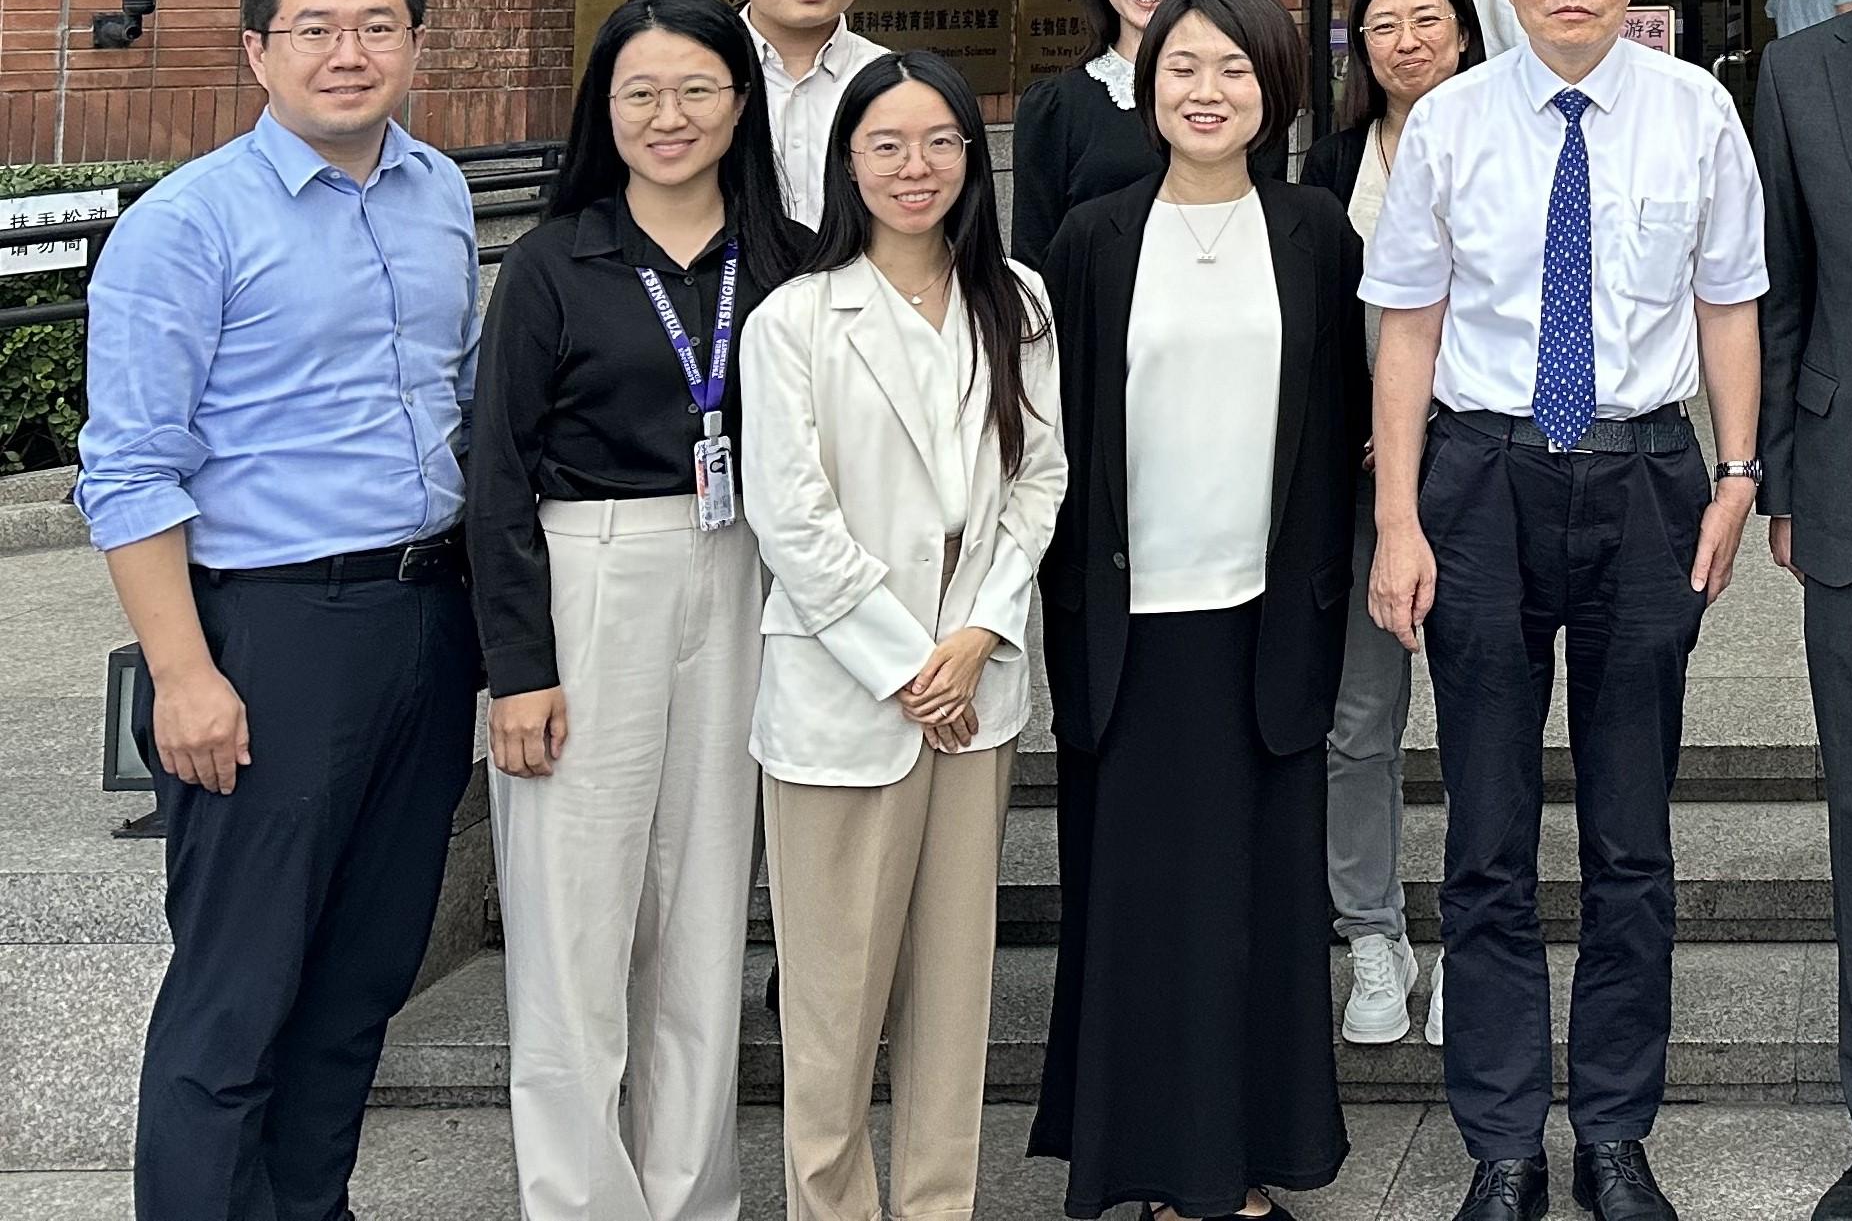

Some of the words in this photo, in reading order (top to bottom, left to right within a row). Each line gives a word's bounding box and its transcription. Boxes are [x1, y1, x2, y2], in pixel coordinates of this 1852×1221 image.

[846, 8, 999, 31] 质科学教育部重点实验室
[1625, 19, 1664, 38] 游客
[964, 46, 996, 57] Science
[1041, 46, 1056, 56] The
[642, 268, 683, 340] TSINGHUA
[718, 259, 736, 330] TSINGHUA
